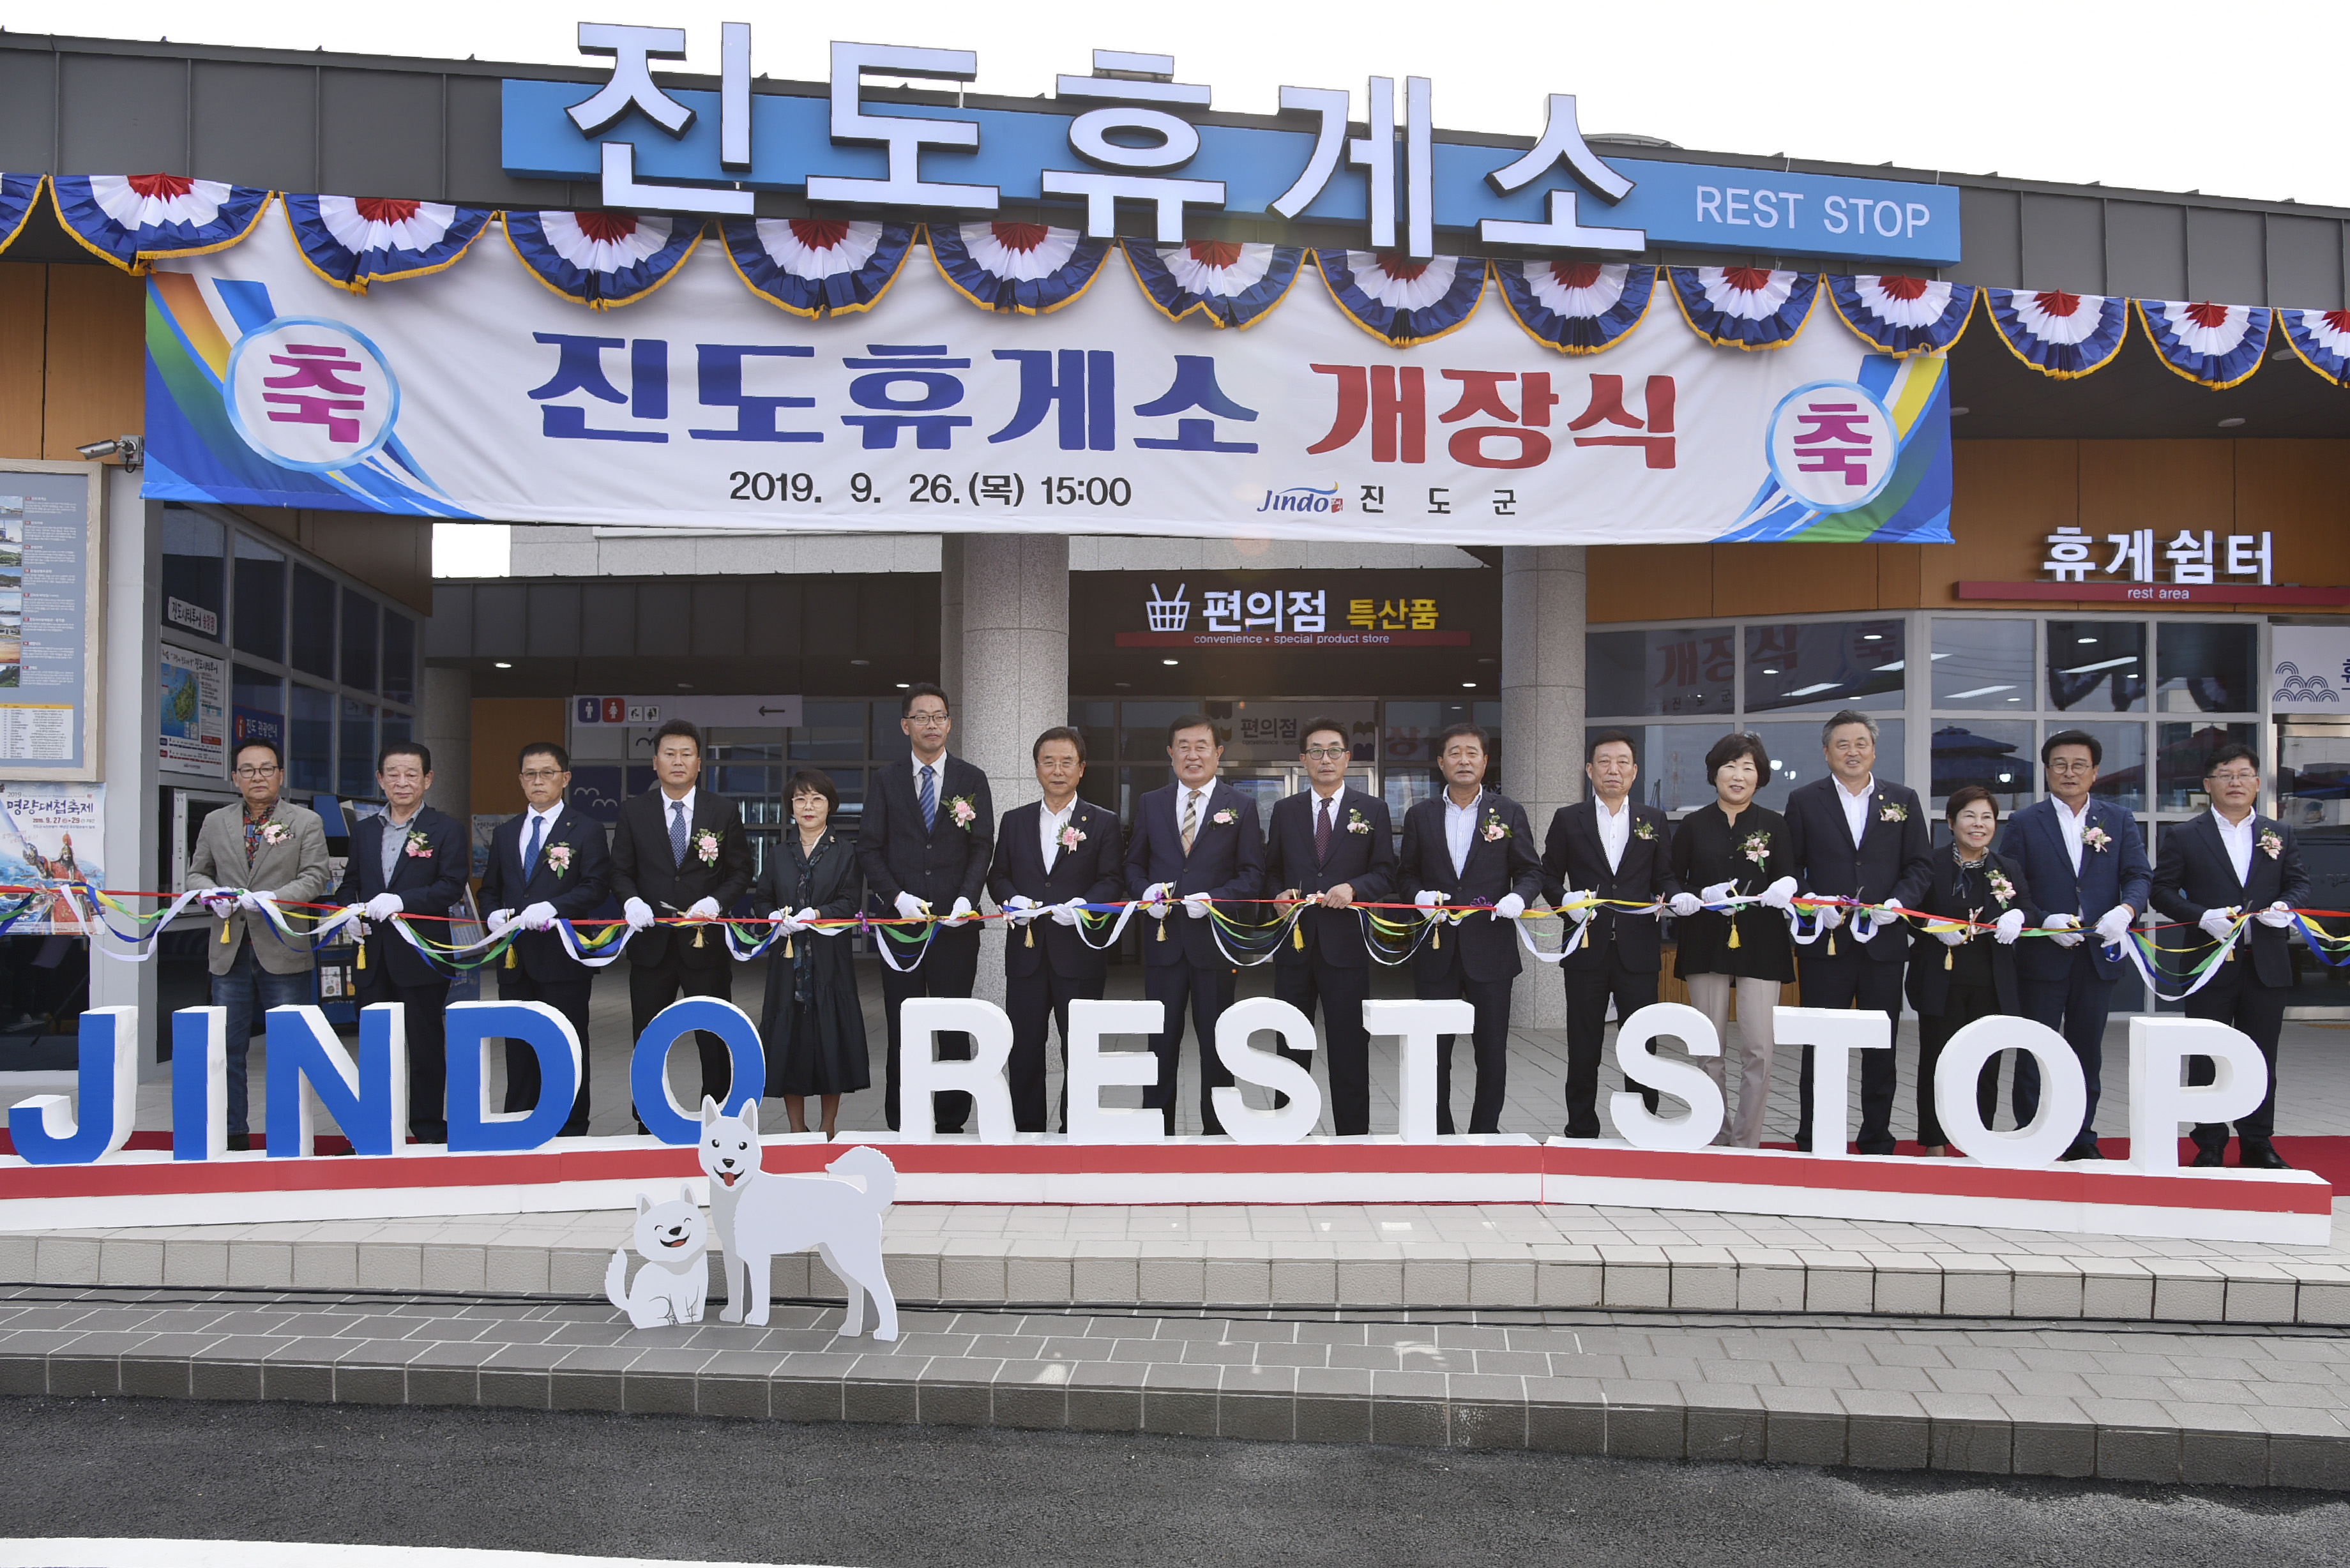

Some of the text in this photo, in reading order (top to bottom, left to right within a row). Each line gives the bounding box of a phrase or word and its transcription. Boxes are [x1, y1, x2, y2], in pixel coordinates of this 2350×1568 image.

[563, 21, 1647, 259] 진도휴게소
[1696, 185, 1930, 238] REST STOP
[262, 344, 366, 443] 축
[527, 331, 1676, 469] 진도휴게소 개장식
[1793, 403, 1873, 486] 축
[729, 471, 822, 503] 2019.
[851, 472, 881, 503] 9.
[1040, 476, 1132, 506] 15:00
[1256, 489, 1330, 513] Jindo
[2042, 526, 2272, 585] 휴게쉼터
[1202, 589, 1439, 633] 편의점 특산품
[2127, 587, 2190, 599] rest area
[1194, 633, 1390, 645] convenience special product store
[1240, 718, 1297, 739] 편의점
[6, 798, 94, 816] 명량대첩축제
[8, 995, 2269, 1177] JINDO REST STOP
